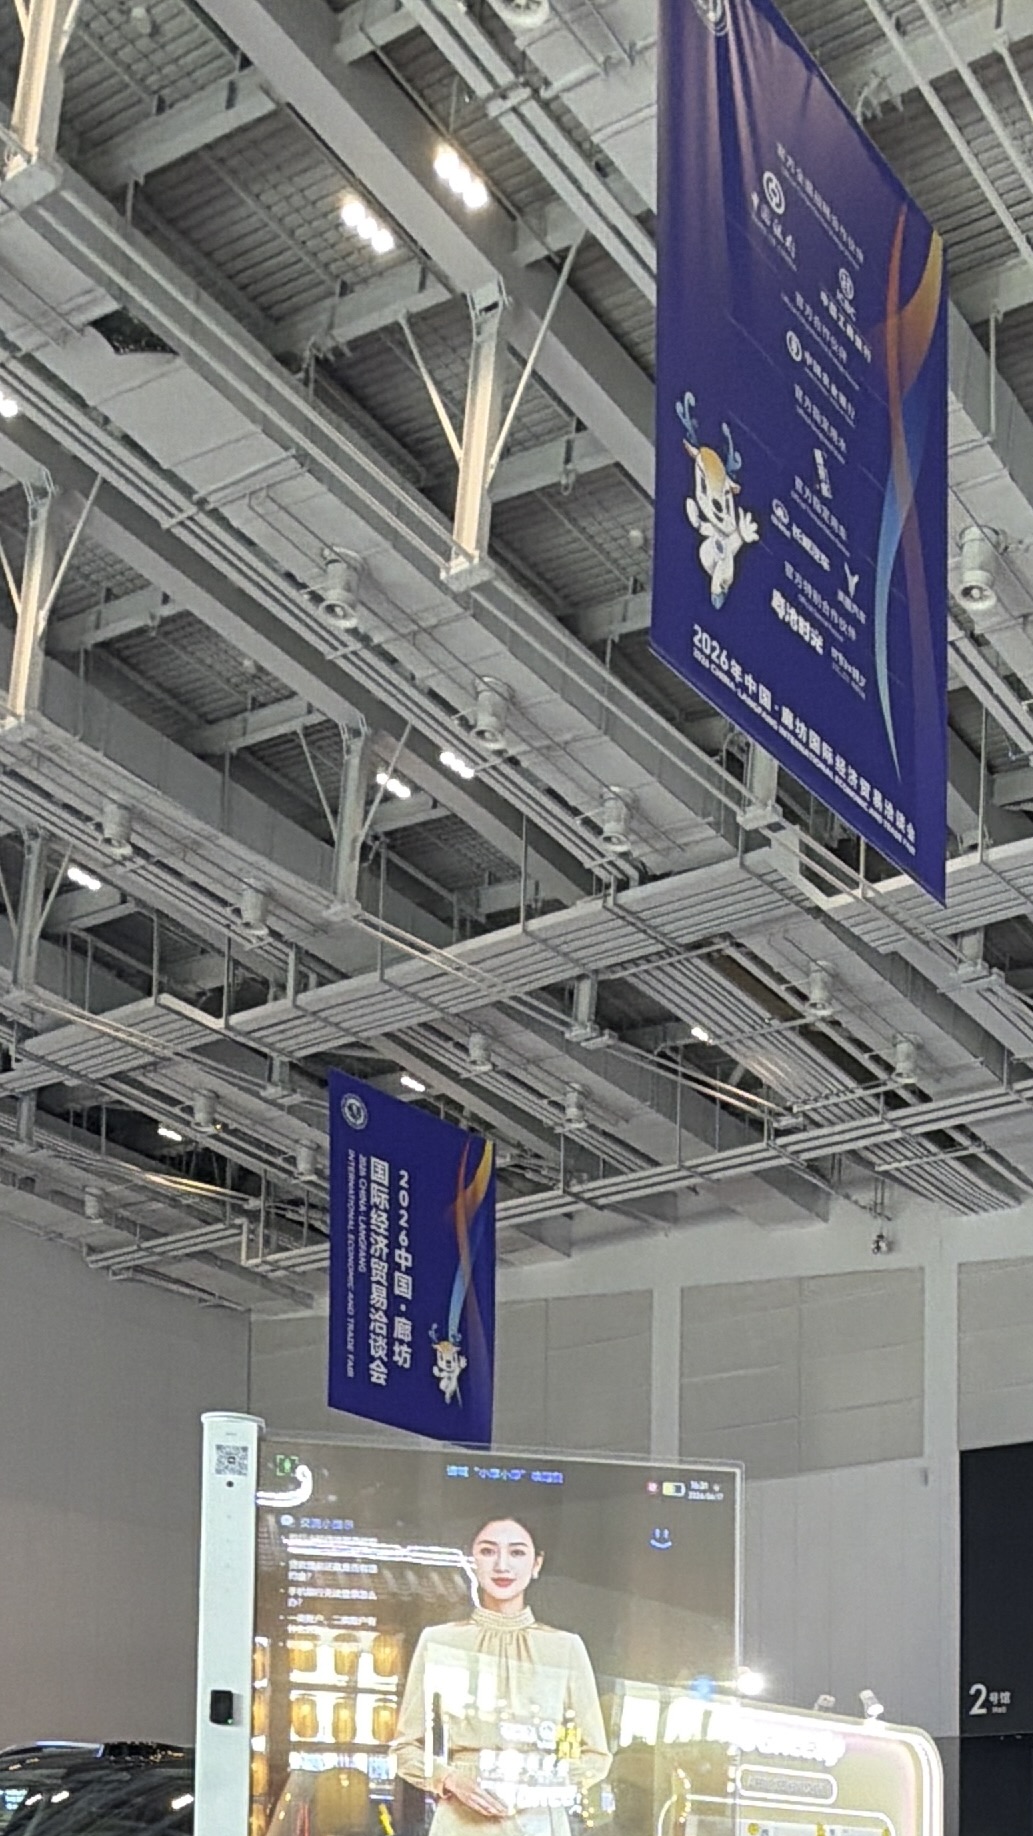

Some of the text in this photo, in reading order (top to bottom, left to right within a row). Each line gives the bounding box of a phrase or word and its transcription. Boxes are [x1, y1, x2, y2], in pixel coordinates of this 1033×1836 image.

[347, 1148, 356, 1232] INTERNATIONAL
[368, 1156, 389, 1386] 国际经济贸易洽谈会
[968, 1683, 988, 1715] 2
